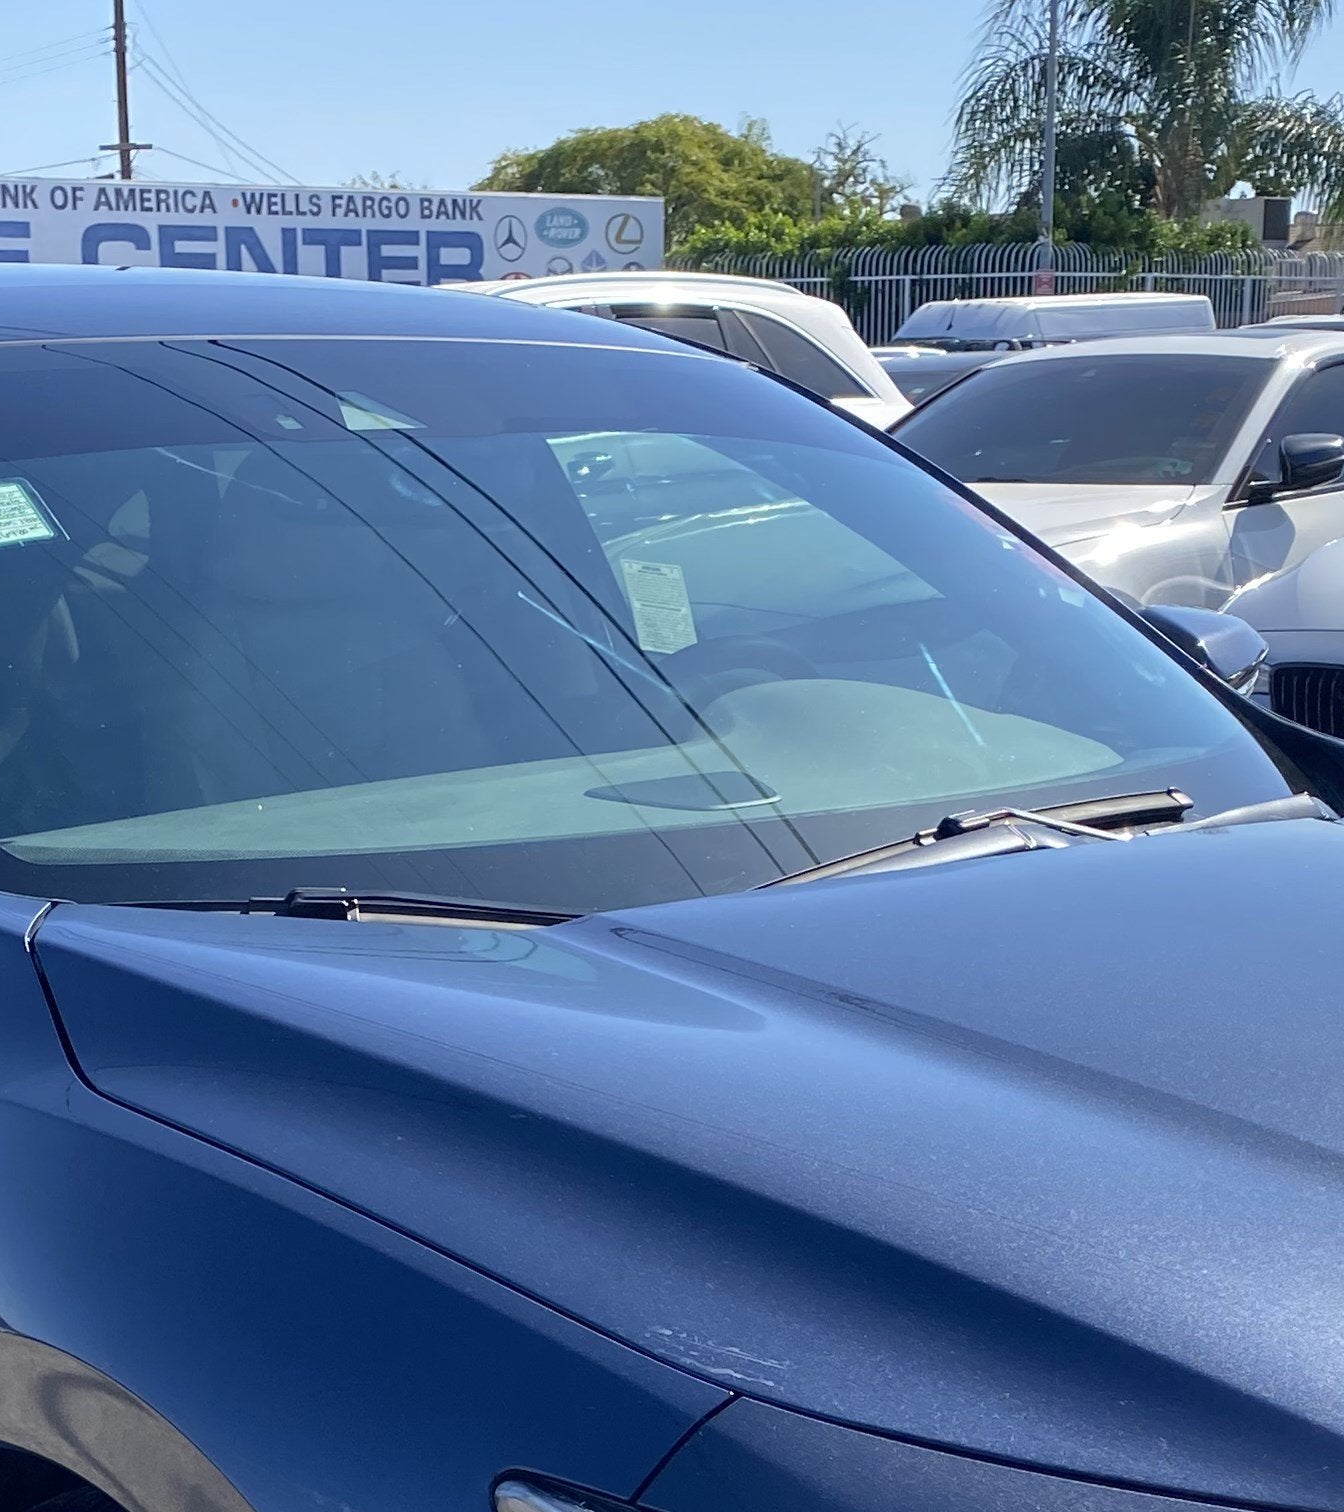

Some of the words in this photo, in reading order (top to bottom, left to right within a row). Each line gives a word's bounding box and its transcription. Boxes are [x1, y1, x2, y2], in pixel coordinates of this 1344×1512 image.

[49, 185, 85, 212] OF
[93, 187, 217, 214] AMERICA
[241, 191, 322, 217] WELLS
[330, 194, 410, 220] FARGO
[419, 197, 484, 221] BANK
